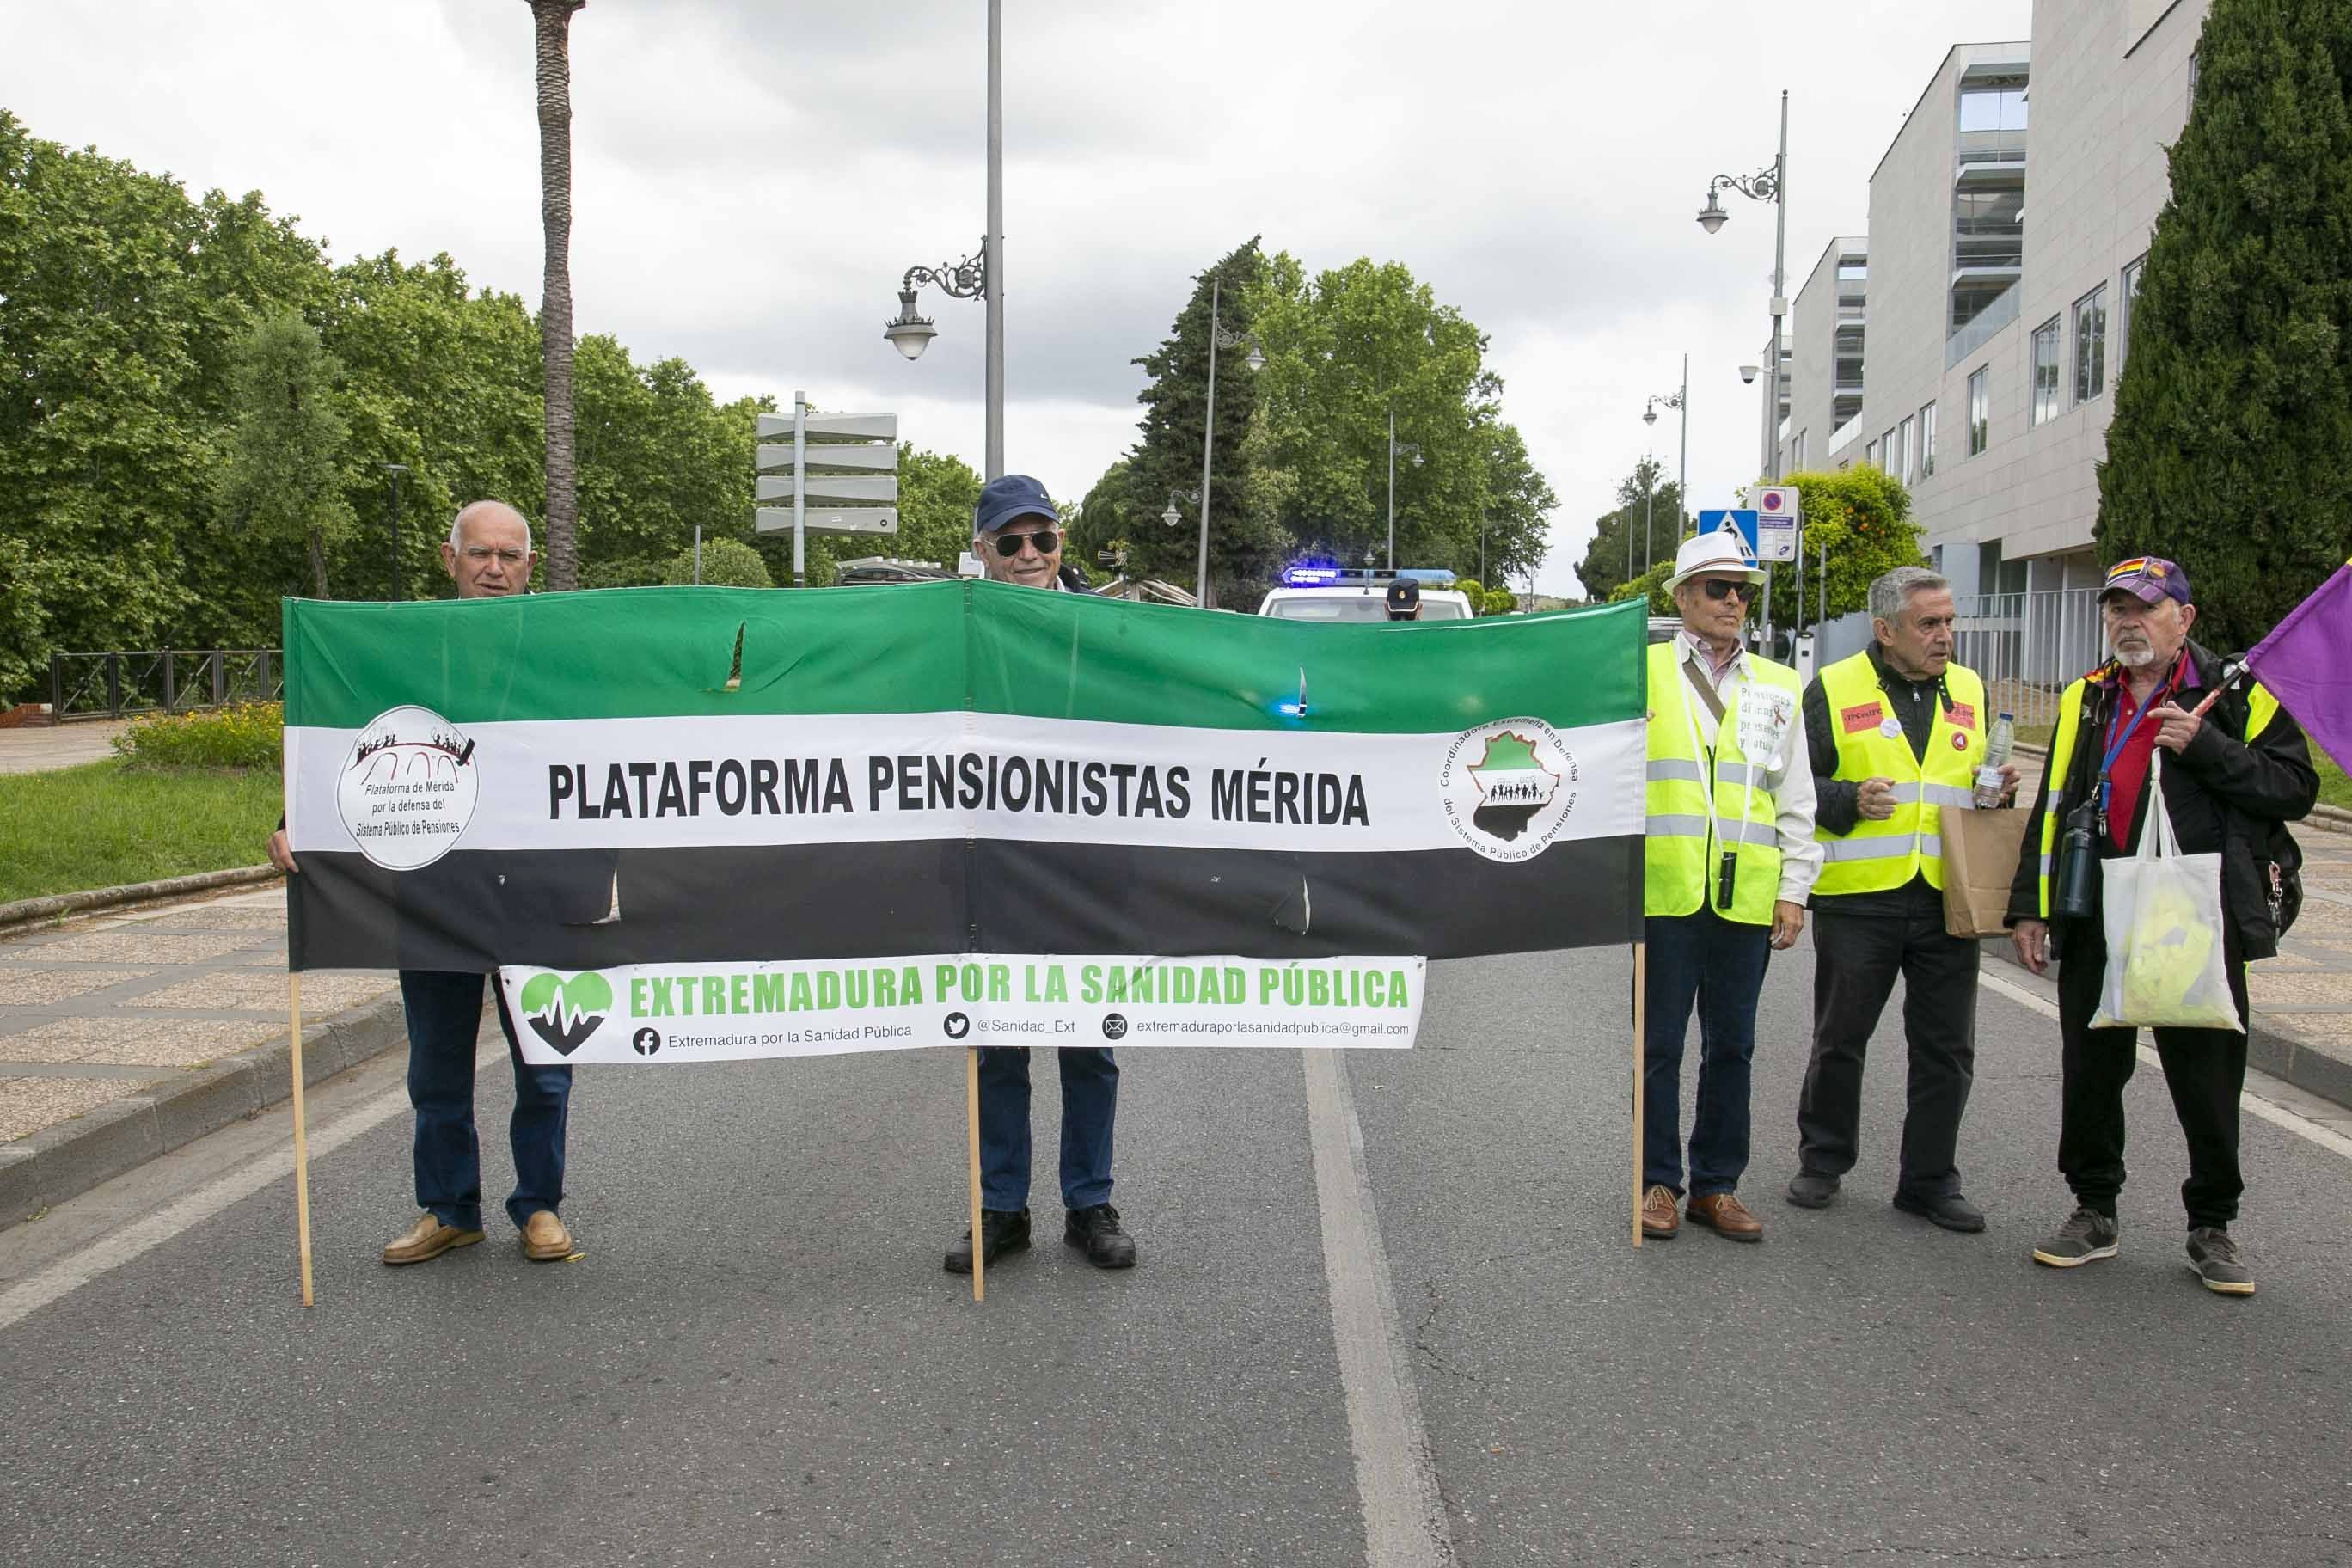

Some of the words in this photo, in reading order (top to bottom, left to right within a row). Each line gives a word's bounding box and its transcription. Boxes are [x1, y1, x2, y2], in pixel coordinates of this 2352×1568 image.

[1440, 724, 1489, 787] Coordinadora
[1544, 726, 1557, 741] en
[1553, 738, 1578, 781] Defensa
[365, 782, 410, 796] Plataforma
[413, 781, 423, 793] de
[426, 780, 455, 793] Mérida
[548, 757, 854, 820] PLATAFORMA
[868, 752, 1191, 819] PENSIONISTAS
[1211, 757, 1370, 826] MÉRIDA
[371, 804, 386, 817] por
[388, 800, 395, 812] la
[398, 799, 431, 812] defensa
[432, 798, 446, 810] del
[356, 822, 383, 837] Sistema
[383, 819, 410, 836] Público
[412, 819, 420, 835] de
[421, 818, 460, 836] Pensiones
[1443, 798, 1455, 816] del
[1451, 817, 1486, 853] Sistema
[1490, 846, 1528, 860] Público
[1530, 842, 1541, 854] de
[1541, 792, 1577, 845] Pensiones
[630, 965, 923, 1018] EXTREMADURA
[935, 963, 1011, 1003] POR
[1025, 965, 1069, 1003] LA
[1080, 965, 1246, 1004] SANIDAD
[1259, 962, 1409, 1008] PÚBLICA
[668, 1032, 756, 1048] Extremadura
[761, 1032, 783, 1045] por
[787, 1030, 799, 1043] la
[804, 1026, 861, 1043] Sanidad
[864, 1024, 912, 1038] Pública
[977, 1018, 1075, 1035] @Sanidad_Ext
[1136, 1020, 1410, 1037] extremaduraporlasanidadpublica@gmail.com
